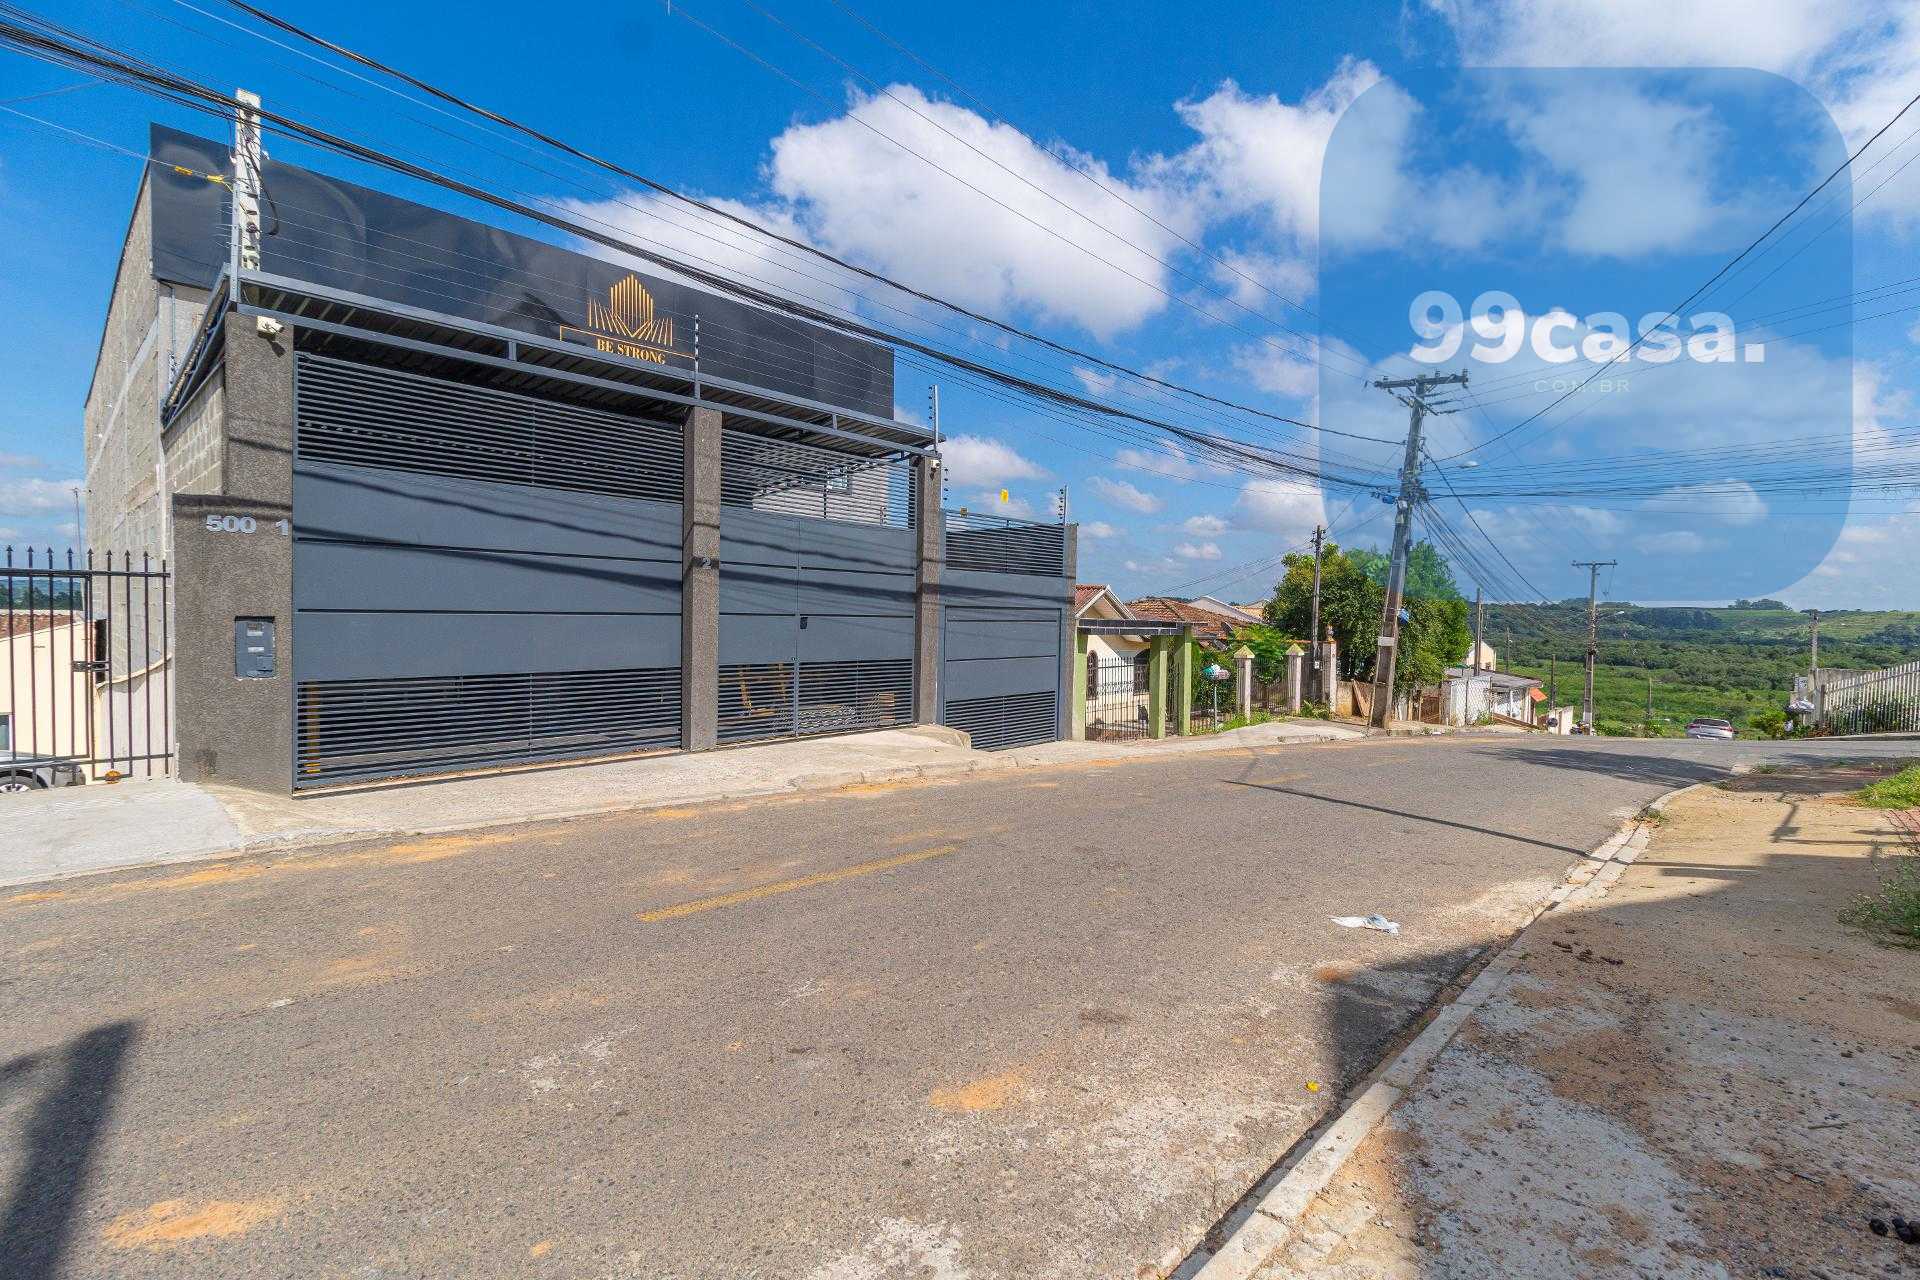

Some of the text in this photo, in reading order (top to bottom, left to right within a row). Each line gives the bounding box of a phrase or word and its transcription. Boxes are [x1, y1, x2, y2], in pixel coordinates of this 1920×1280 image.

[597, 339, 666, 365] BE STRONG
[206, 514, 257, 534] 500
[275, 518, 289, 537] 1
